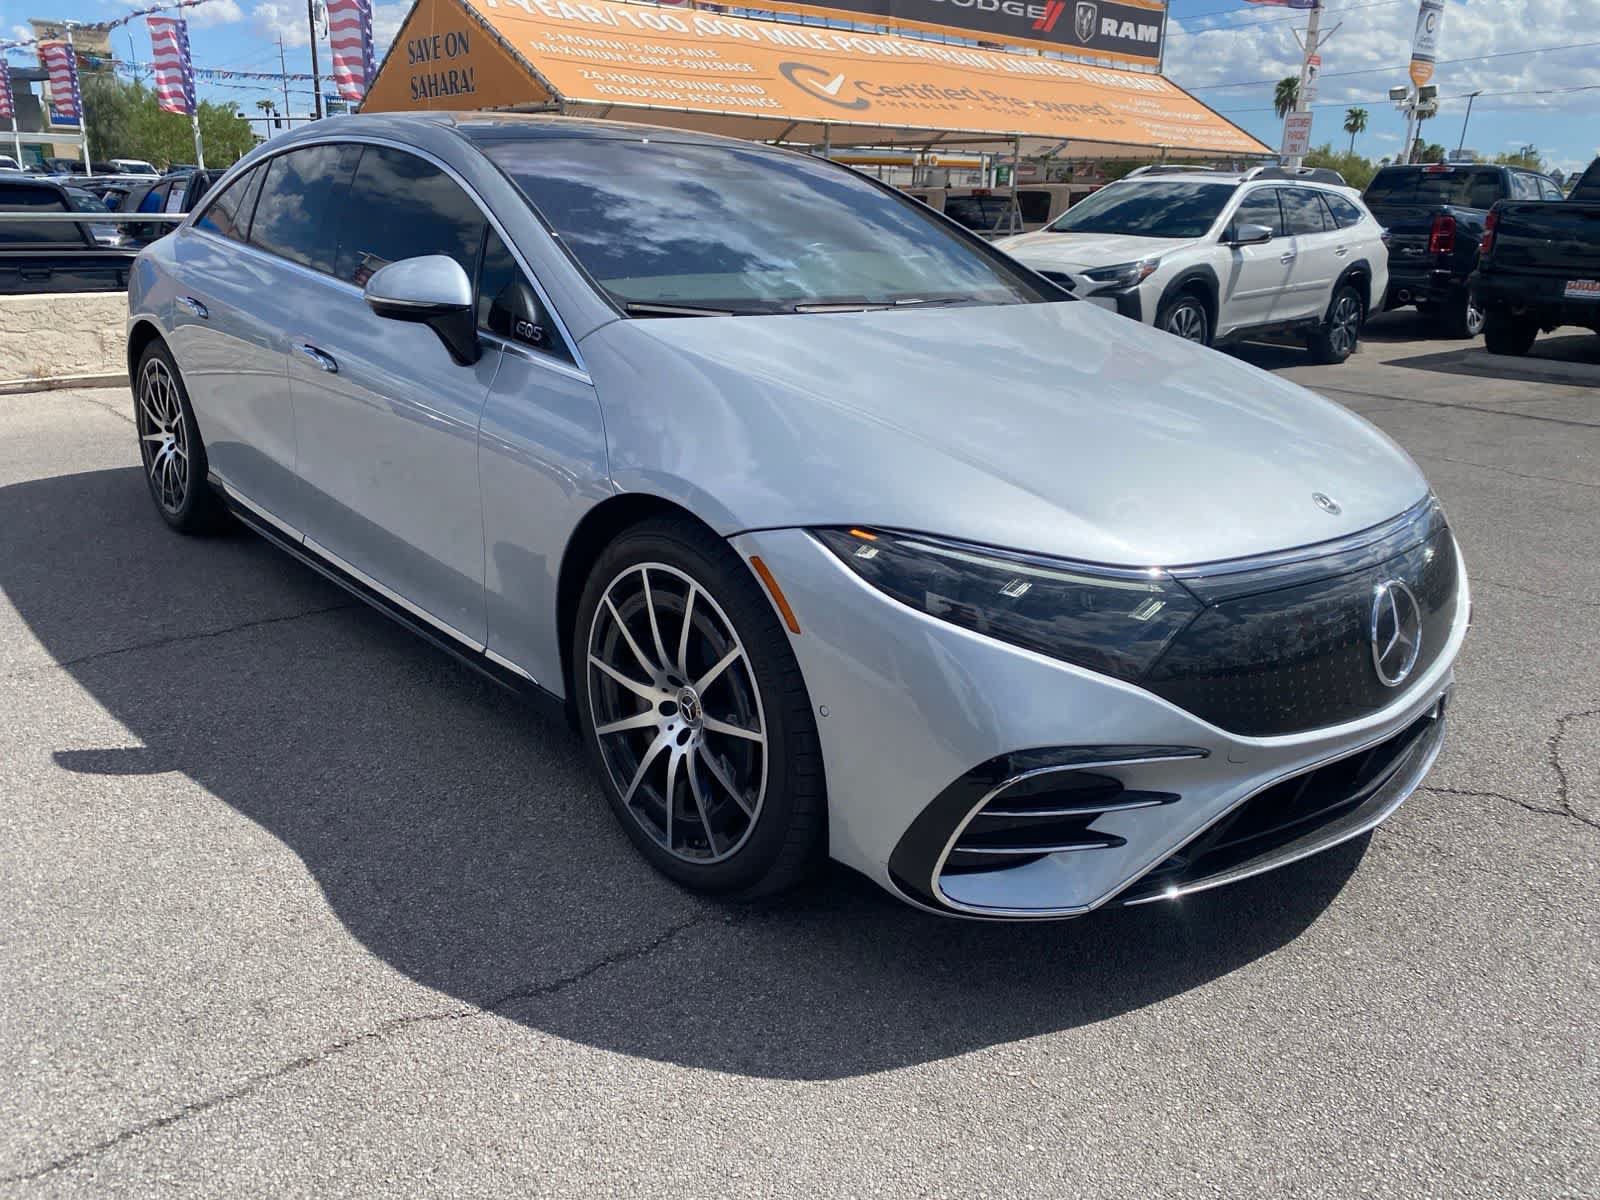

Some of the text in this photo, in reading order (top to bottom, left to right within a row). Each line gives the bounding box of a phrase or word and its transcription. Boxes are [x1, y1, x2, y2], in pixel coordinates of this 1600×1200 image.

[1101, 17, 1158, 43] RAM
[408, 30, 469, 65] SAVE ON
[757, 26, 837, 51] MILE
[831, 35, 997, 70] POWERTRAIN
[410, 66, 475, 100] SAHARA!
[853, 79, 984, 102] Certified
